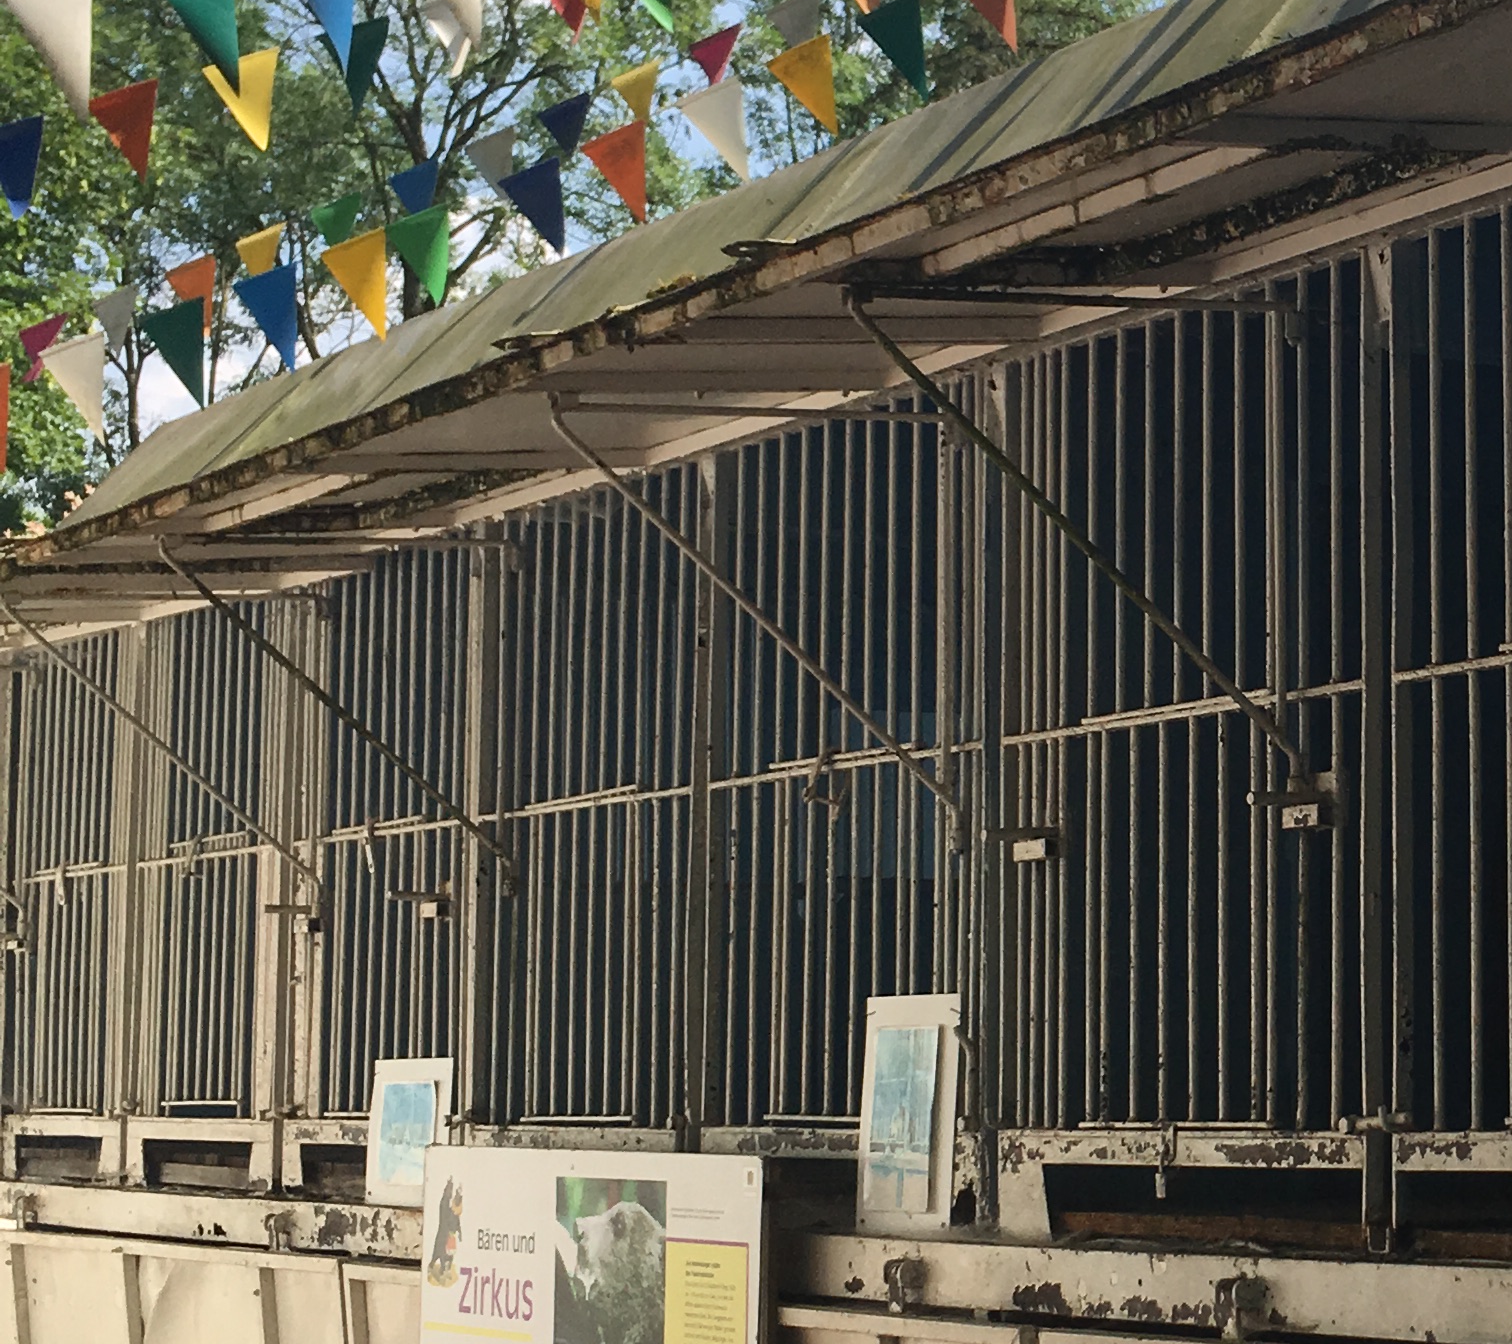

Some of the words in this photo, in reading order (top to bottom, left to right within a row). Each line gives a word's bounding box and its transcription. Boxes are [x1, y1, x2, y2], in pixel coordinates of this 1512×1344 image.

[477, 1228, 509, 1252] Bären
[512, 1231, 536, 1254] und
[458, 1266, 534, 1322] Zirkus
